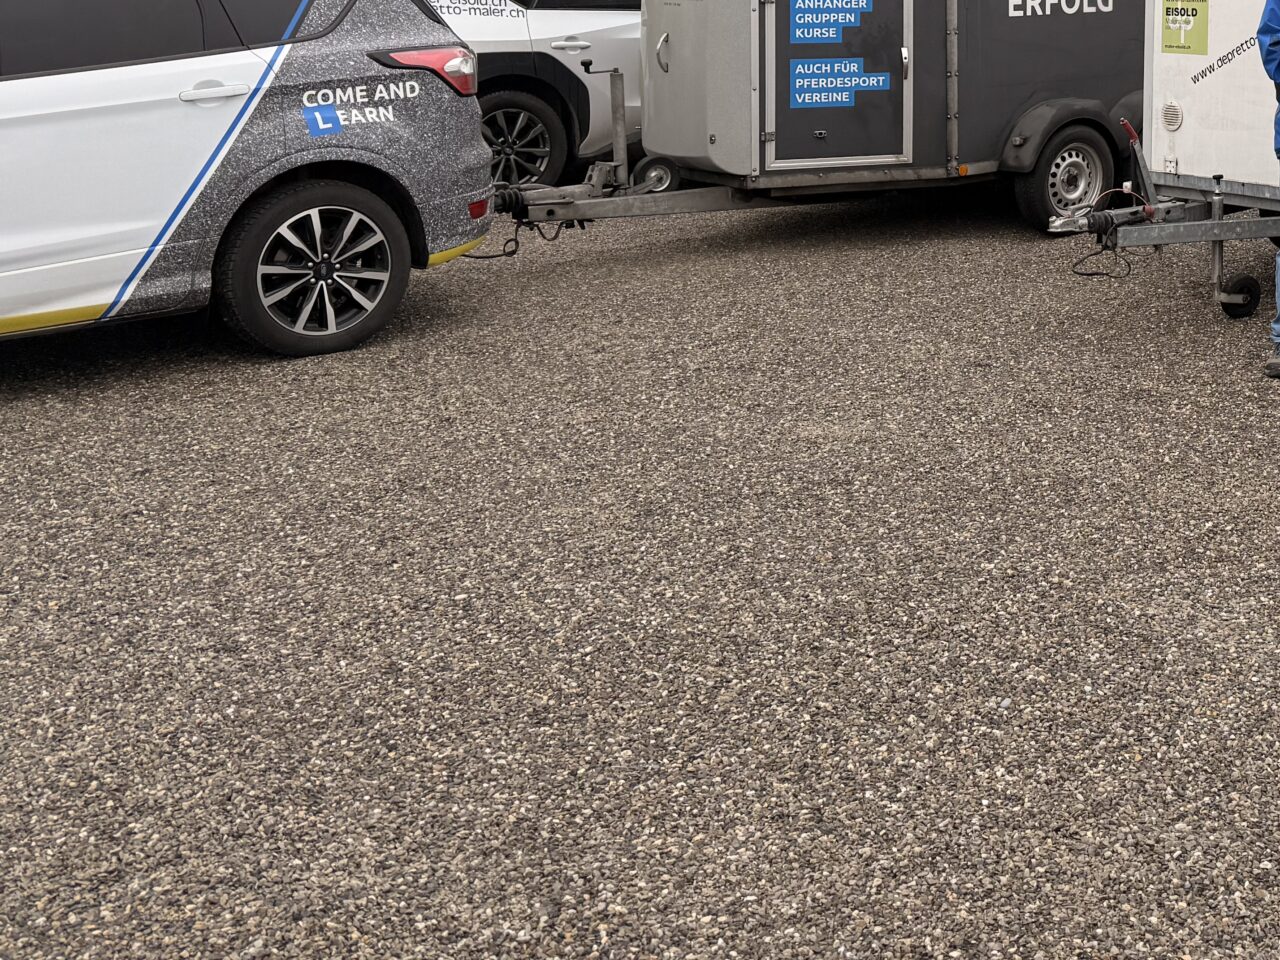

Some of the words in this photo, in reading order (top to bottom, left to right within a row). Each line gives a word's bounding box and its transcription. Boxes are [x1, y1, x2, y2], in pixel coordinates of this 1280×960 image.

[1165, 7, 1198, 17] EISOLD
[795, 13, 855, 24] GRUPPEN
[795, 28, 837, 38] KURSE
[795, 63, 831, 74] AUCH
[834, 60, 858, 73] FÜR
[795, 76, 885, 88] PFERDESPORT
[302, 85, 369, 107] COME
[374, 81, 419, 100] AND
[795, 92, 850, 103] VEREINE
[314, 105, 395, 130] LEARN
